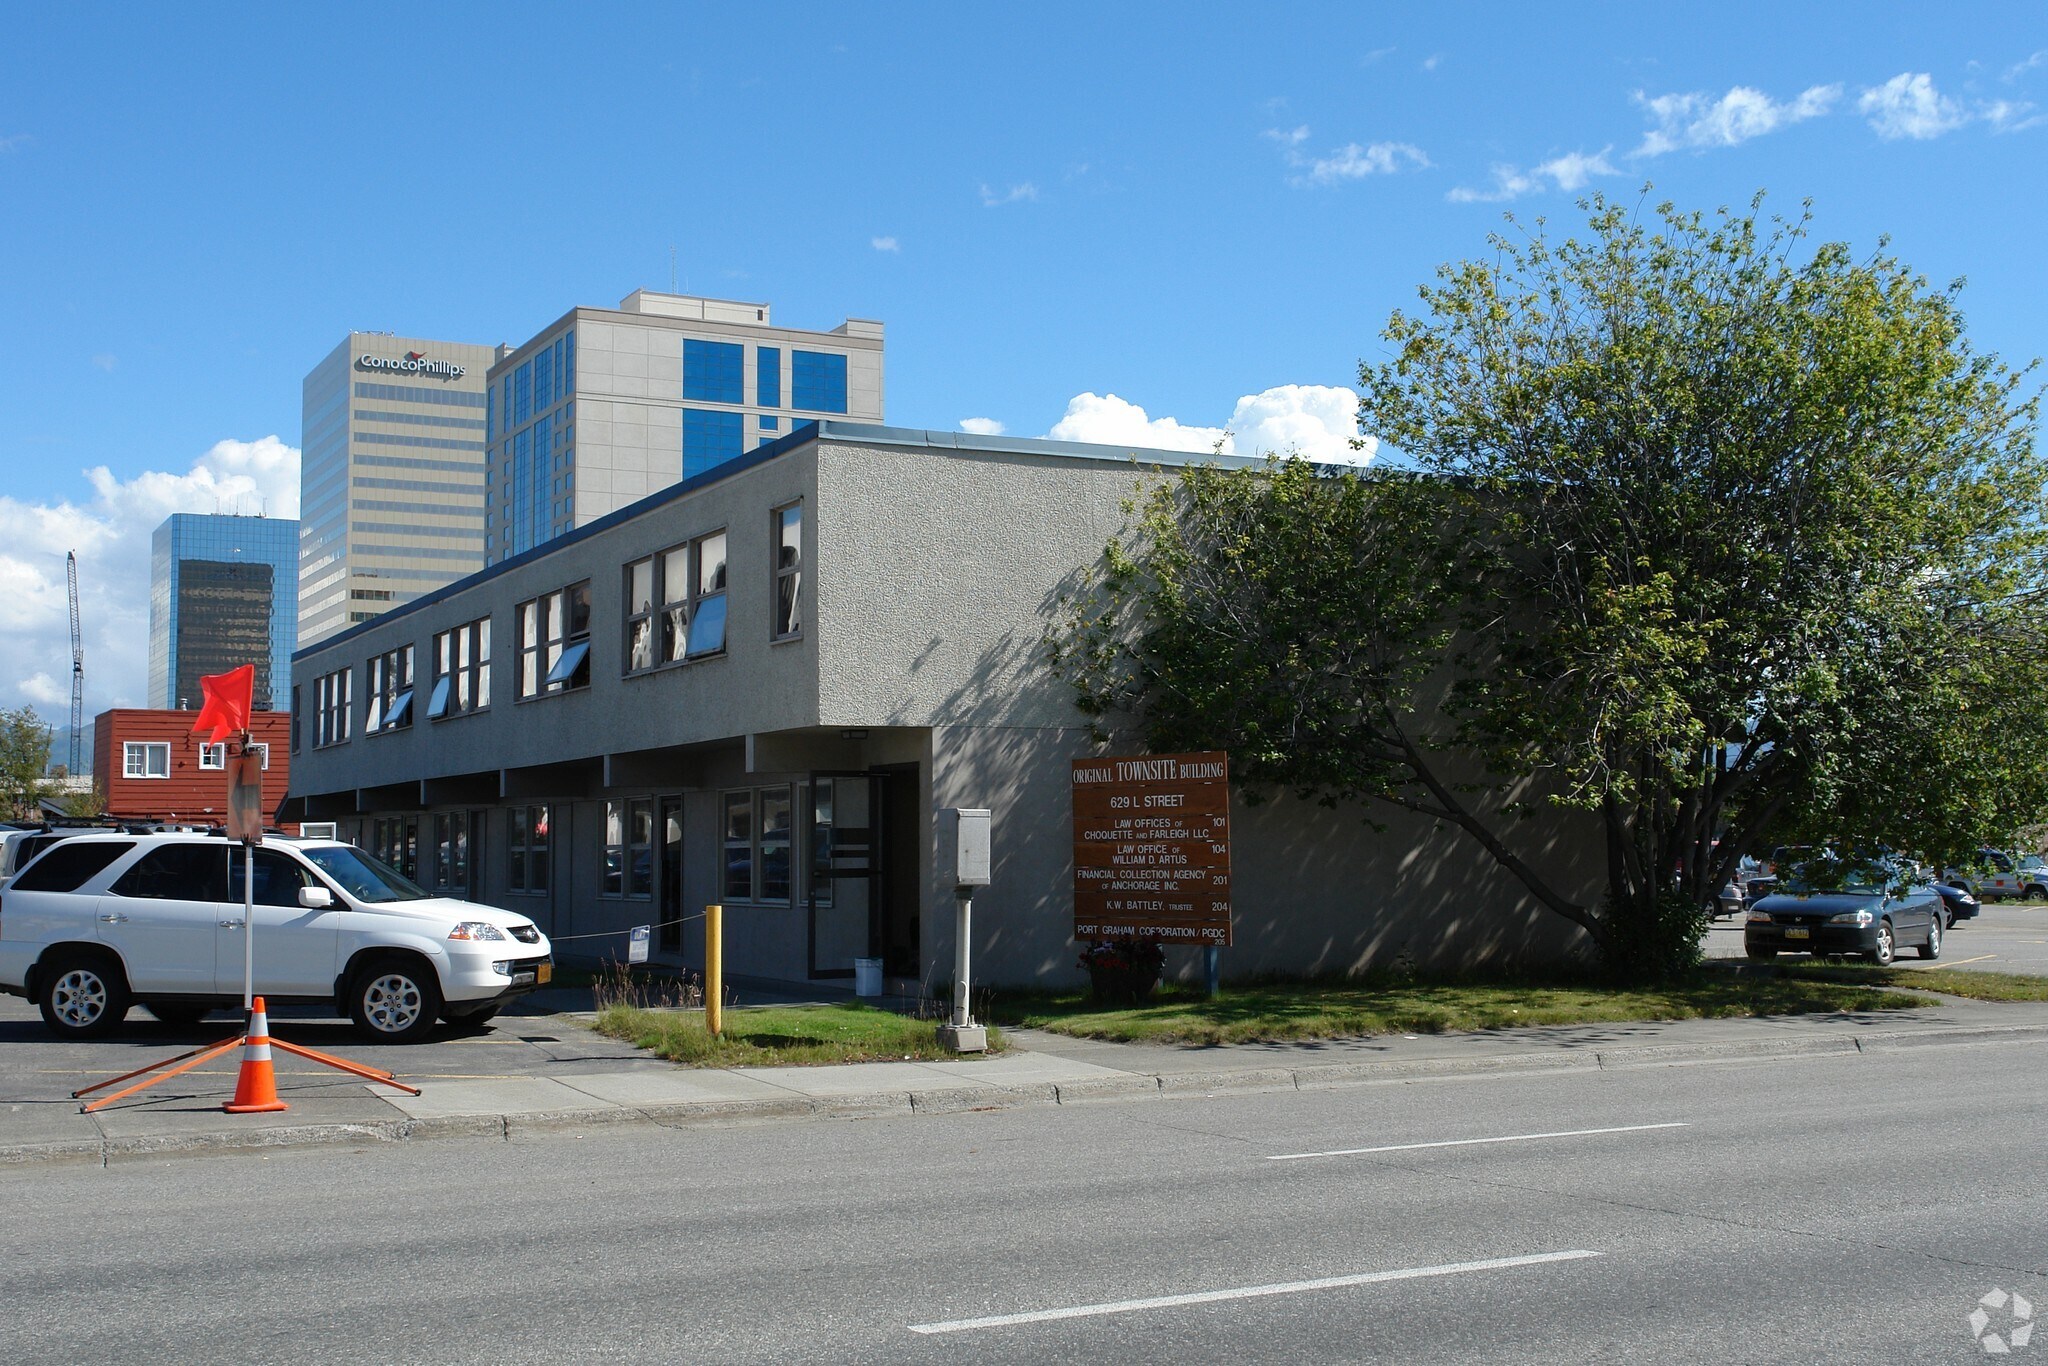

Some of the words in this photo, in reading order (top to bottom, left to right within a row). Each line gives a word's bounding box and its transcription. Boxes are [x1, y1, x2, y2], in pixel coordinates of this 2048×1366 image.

[360, 353, 467, 377] ConocoPhillips
[1073, 768, 1113, 783] ORIGINAL
[1116, 759, 1177, 782] TOWNSITE
[1180, 762, 1224, 779] BUILDING
[1110, 796, 1130, 808] 629
[1133, 796, 1140, 808] L
[1144, 794, 1185, 807] STREET
[1114, 819, 1132, 829] LAW
[1134, 818, 1171, 828] OFFICES
[1212, 817, 1226, 827] 101
[1084, 830, 1133, 840] CHOQUETTE
[1149, 829, 1190, 839] FARLEIGH
[1193, 828, 1209, 838] LLC
[1117, 844, 1134, 854] LAW
[1137, 844, 1167, 854] OFFICE
[1211, 844, 1226, 854] 104
[1112, 855, 1146, 865] WILLIAM
[1148, 855, 1156, 864] D.
[1158, 855, 1188, 864] ARTUS
[1077, 869, 1116, 879] FINANCIAL
[1119, 869, 1170, 879] COLLECTION
[1173, 870, 1206, 879] AGENCY
[1212, 875, 1228, 885] 201
[1111, 881, 1160, 891] ANCHORAGE
[1164, 881, 1180, 891] INC.
[1168, 903, 1194, 911] TRUSTEE
[1211, 901, 1228, 911] 204
[1077, 924, 1099, 934] PORT
[1102, 925, 1135, 936] GRAHAM
[1214, 938, 1226, 946] 205
